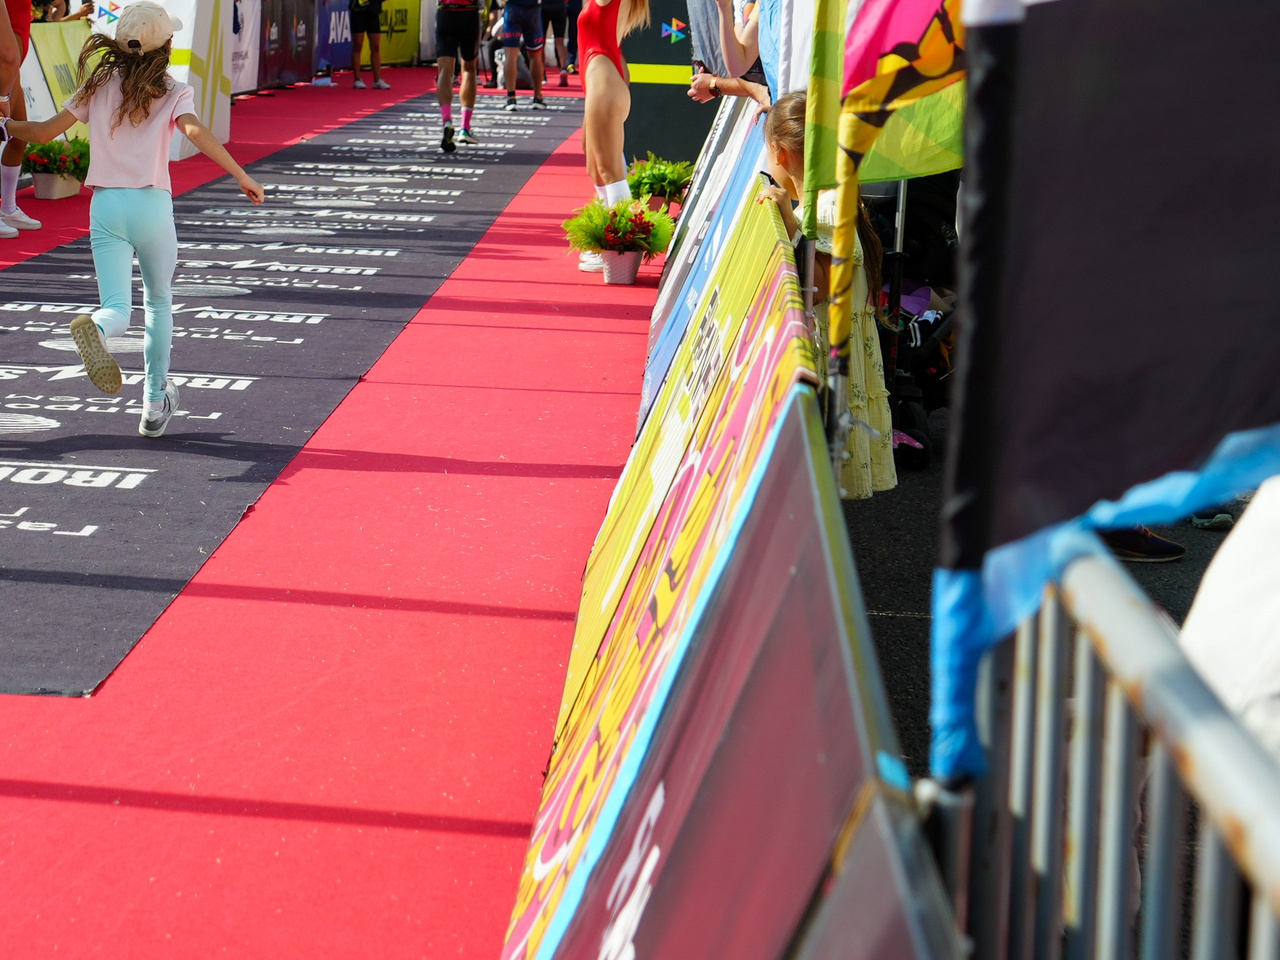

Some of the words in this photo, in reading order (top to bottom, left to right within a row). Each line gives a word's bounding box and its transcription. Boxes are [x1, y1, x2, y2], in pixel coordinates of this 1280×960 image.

[328, 11, 352, 44] AVA
[295, 247, 399, 256] IRON
[266, 265, 378, 275] IRON
[194, 309, 326, 325] IRON
